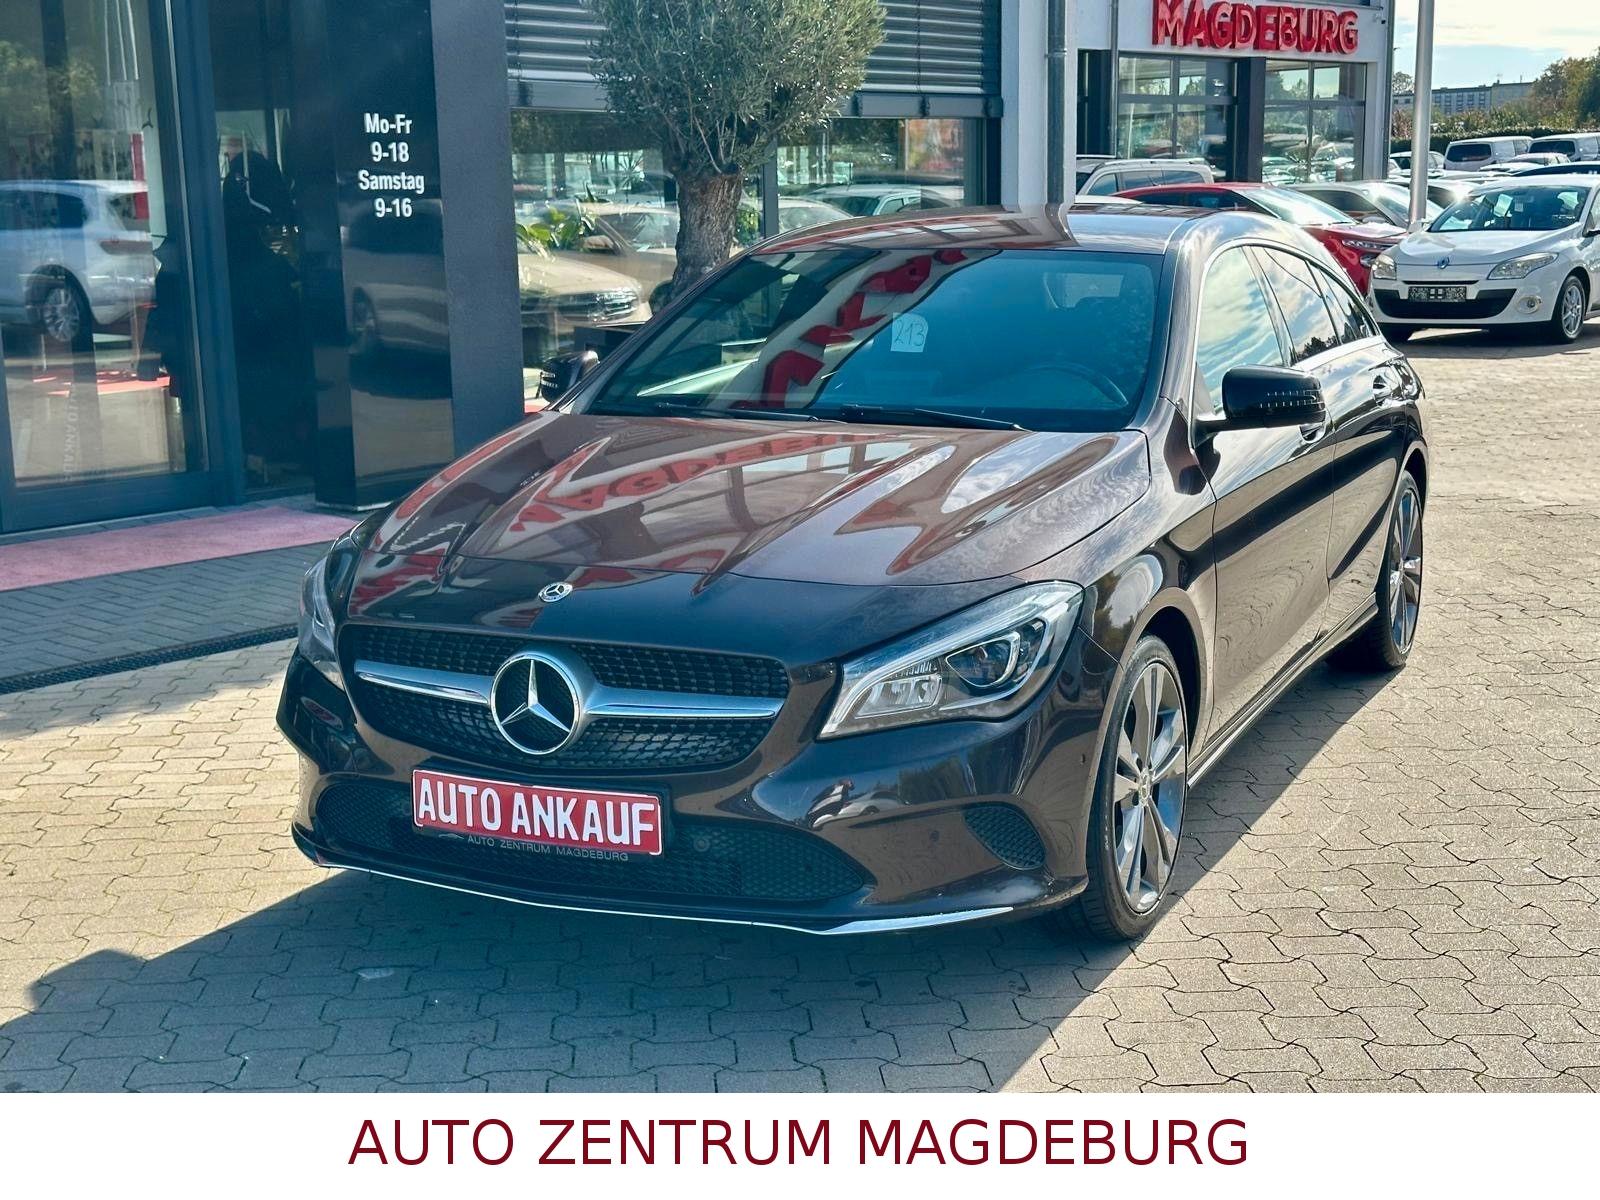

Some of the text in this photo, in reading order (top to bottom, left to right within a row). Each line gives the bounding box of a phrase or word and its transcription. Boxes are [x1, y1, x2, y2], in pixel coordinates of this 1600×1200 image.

[1152, 0, 1359, 54] MAGDEBURG
[364, 112, 413, 134] Mo-Fr
[371, 141, 410, 162] 9-18
[358, 169, 425, 194] Samstag
[374, 197, 413, 218] 9-16
[418, 778, 655, 846] AUTO ANKAUF
[467, 836, 629, 862] AUTO ZENTRUM MAGDEBURG
